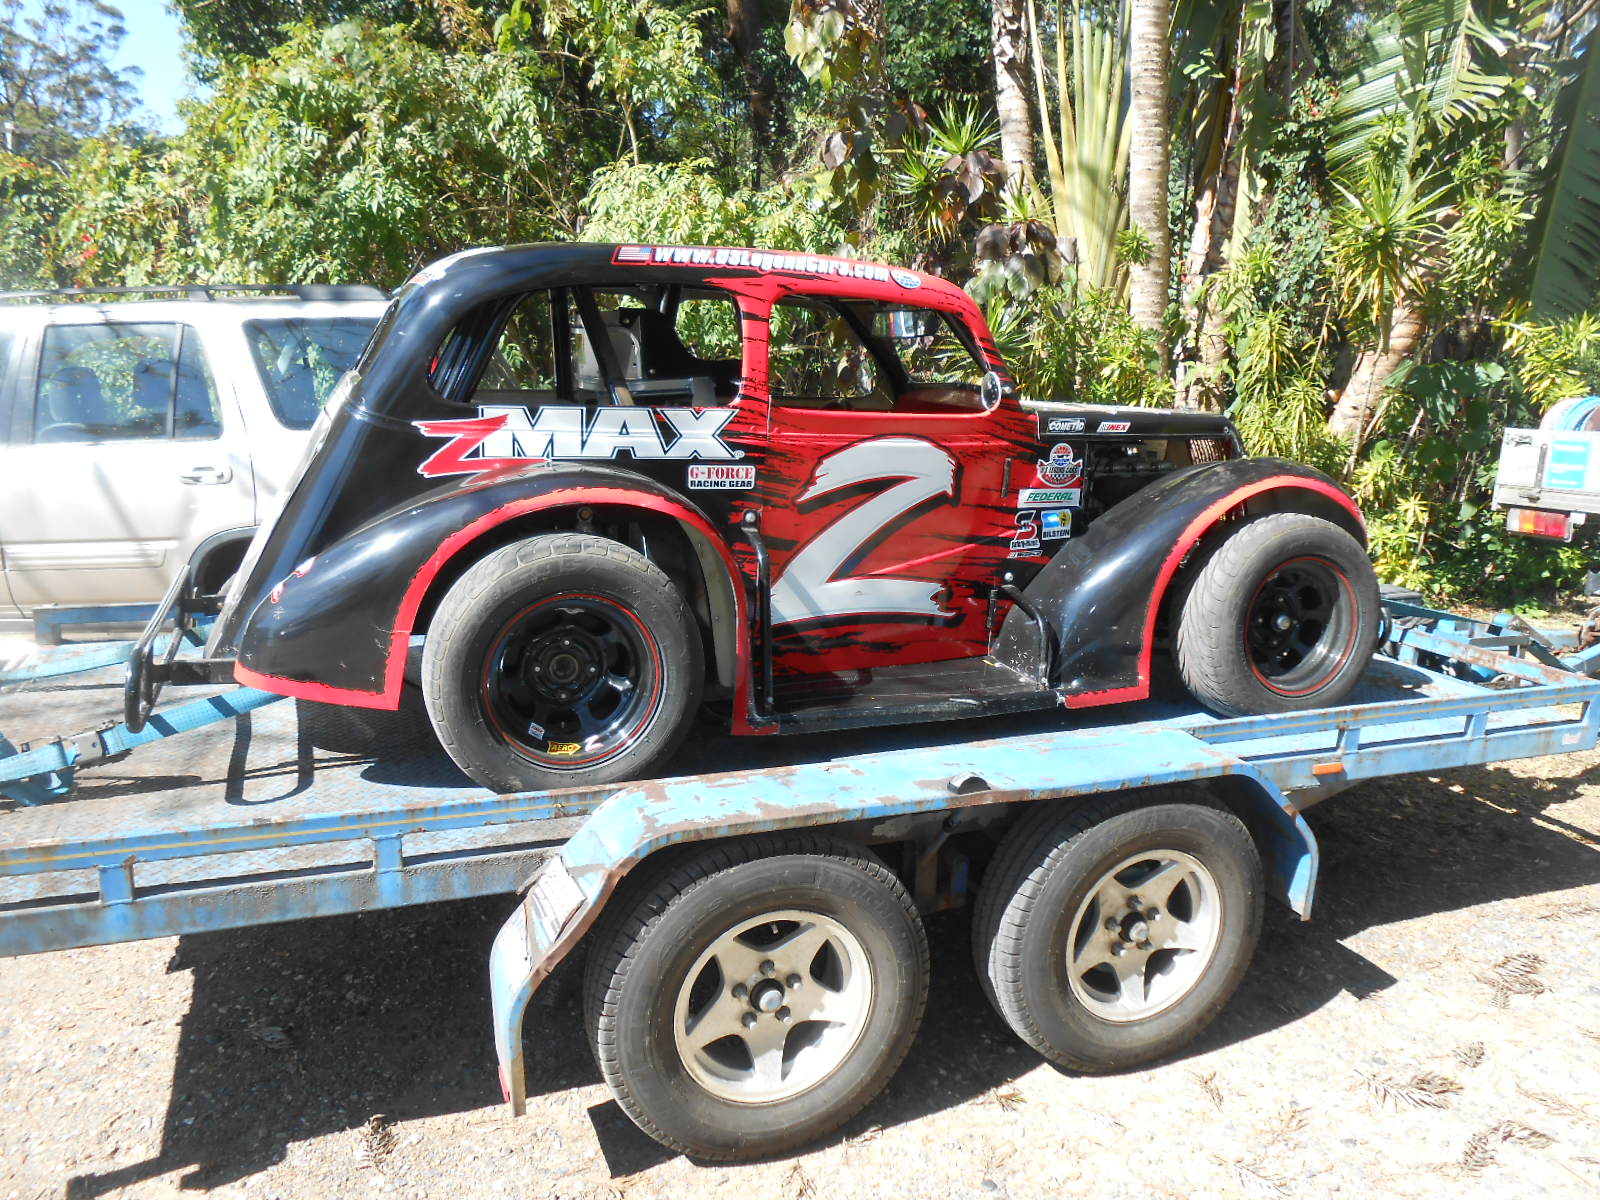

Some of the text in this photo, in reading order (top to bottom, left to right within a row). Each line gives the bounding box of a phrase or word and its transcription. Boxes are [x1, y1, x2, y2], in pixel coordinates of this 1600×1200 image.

[690, 466, 753, 479] G-FORCE
[690, 480, 753, 488] RACING GEAR
[1026, 492, 1073, 501] FEDERAL
[1043, 529, 1070, 538] BILSTEIN
